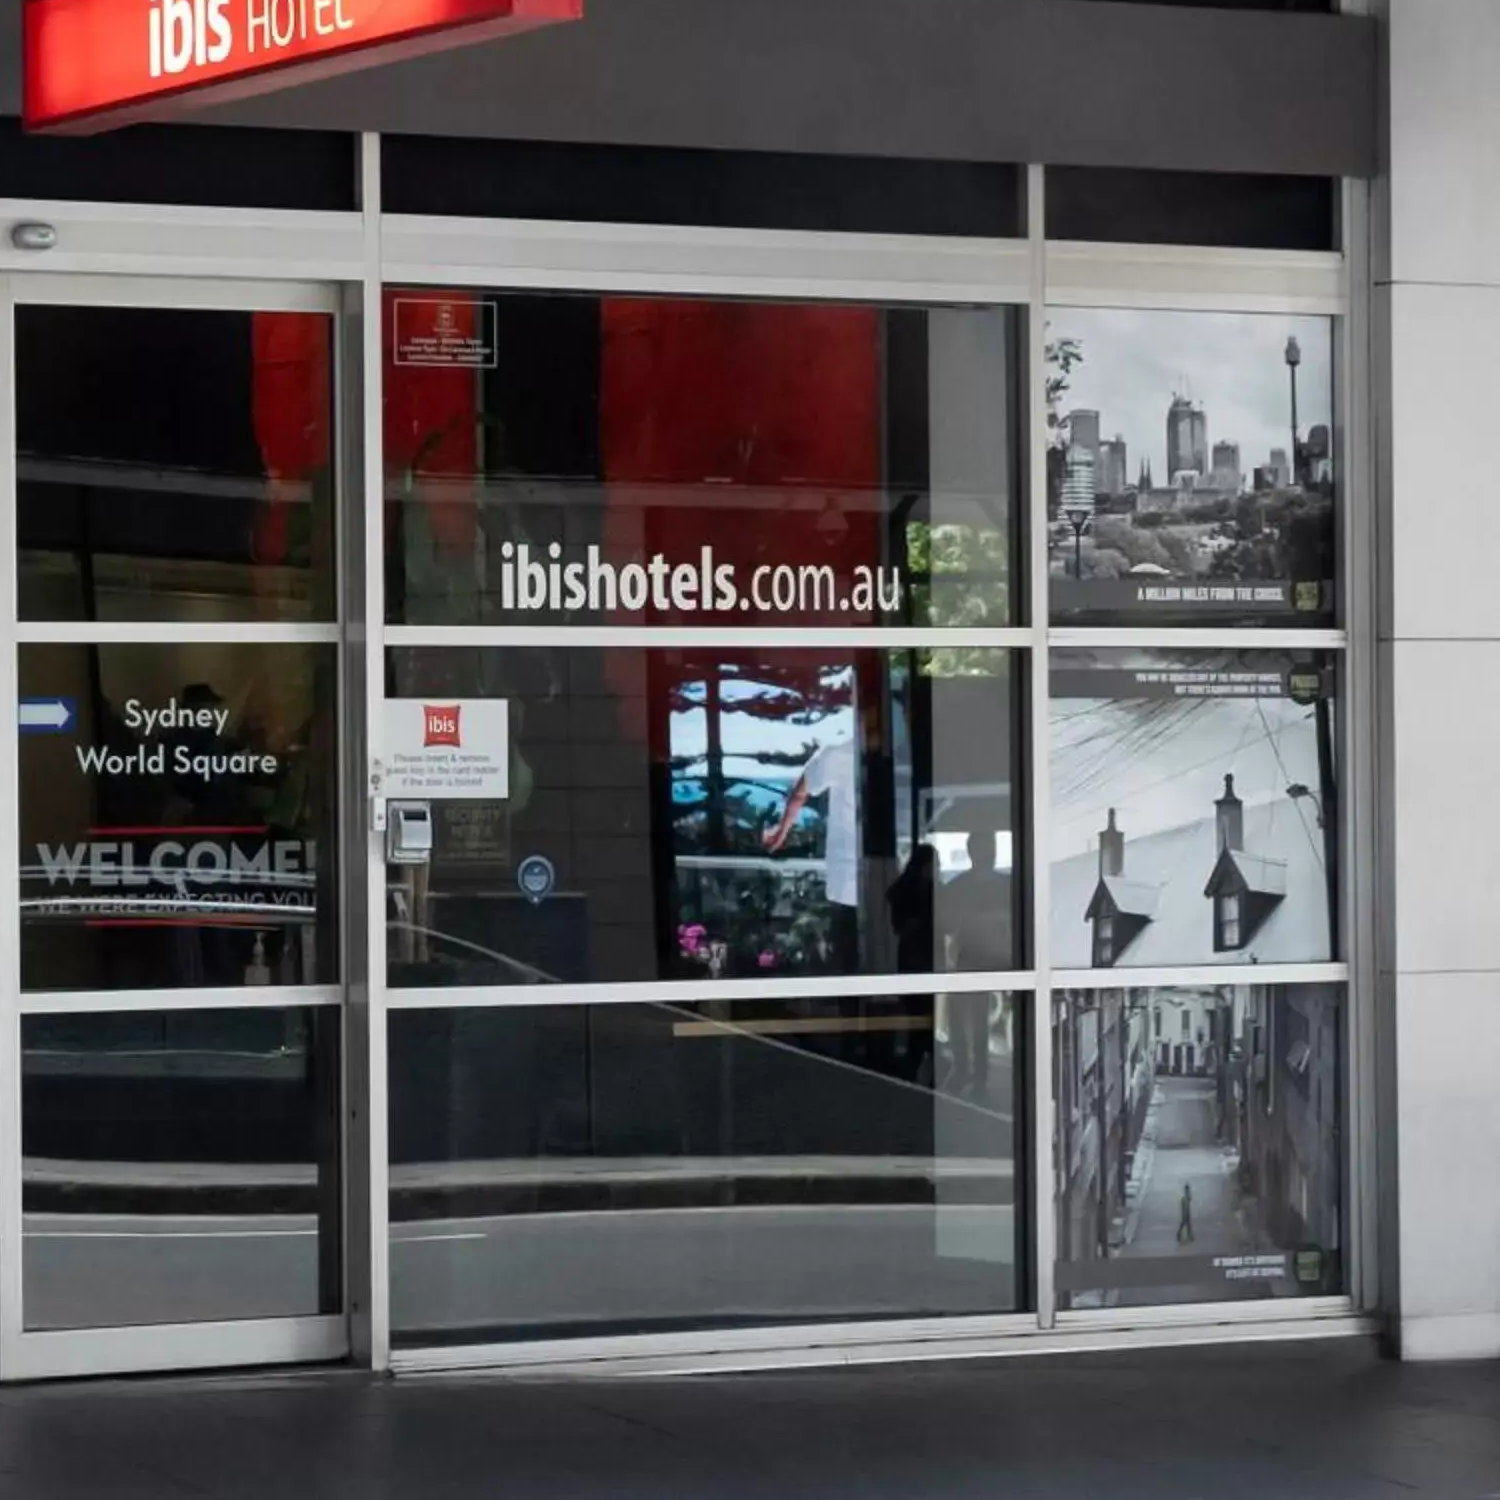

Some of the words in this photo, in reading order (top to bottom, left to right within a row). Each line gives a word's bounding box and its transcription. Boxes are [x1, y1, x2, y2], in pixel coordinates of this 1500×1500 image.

[501, 542, 901, 612] ibishotels.com.au
[124, 698, 229, 736] Sydney
[429, 715, 456, 734] ibis
[76, 744, 164, 773] World
[174, 746, 277, 781] Square
[36, 840, 317, 887] WELCOME!
